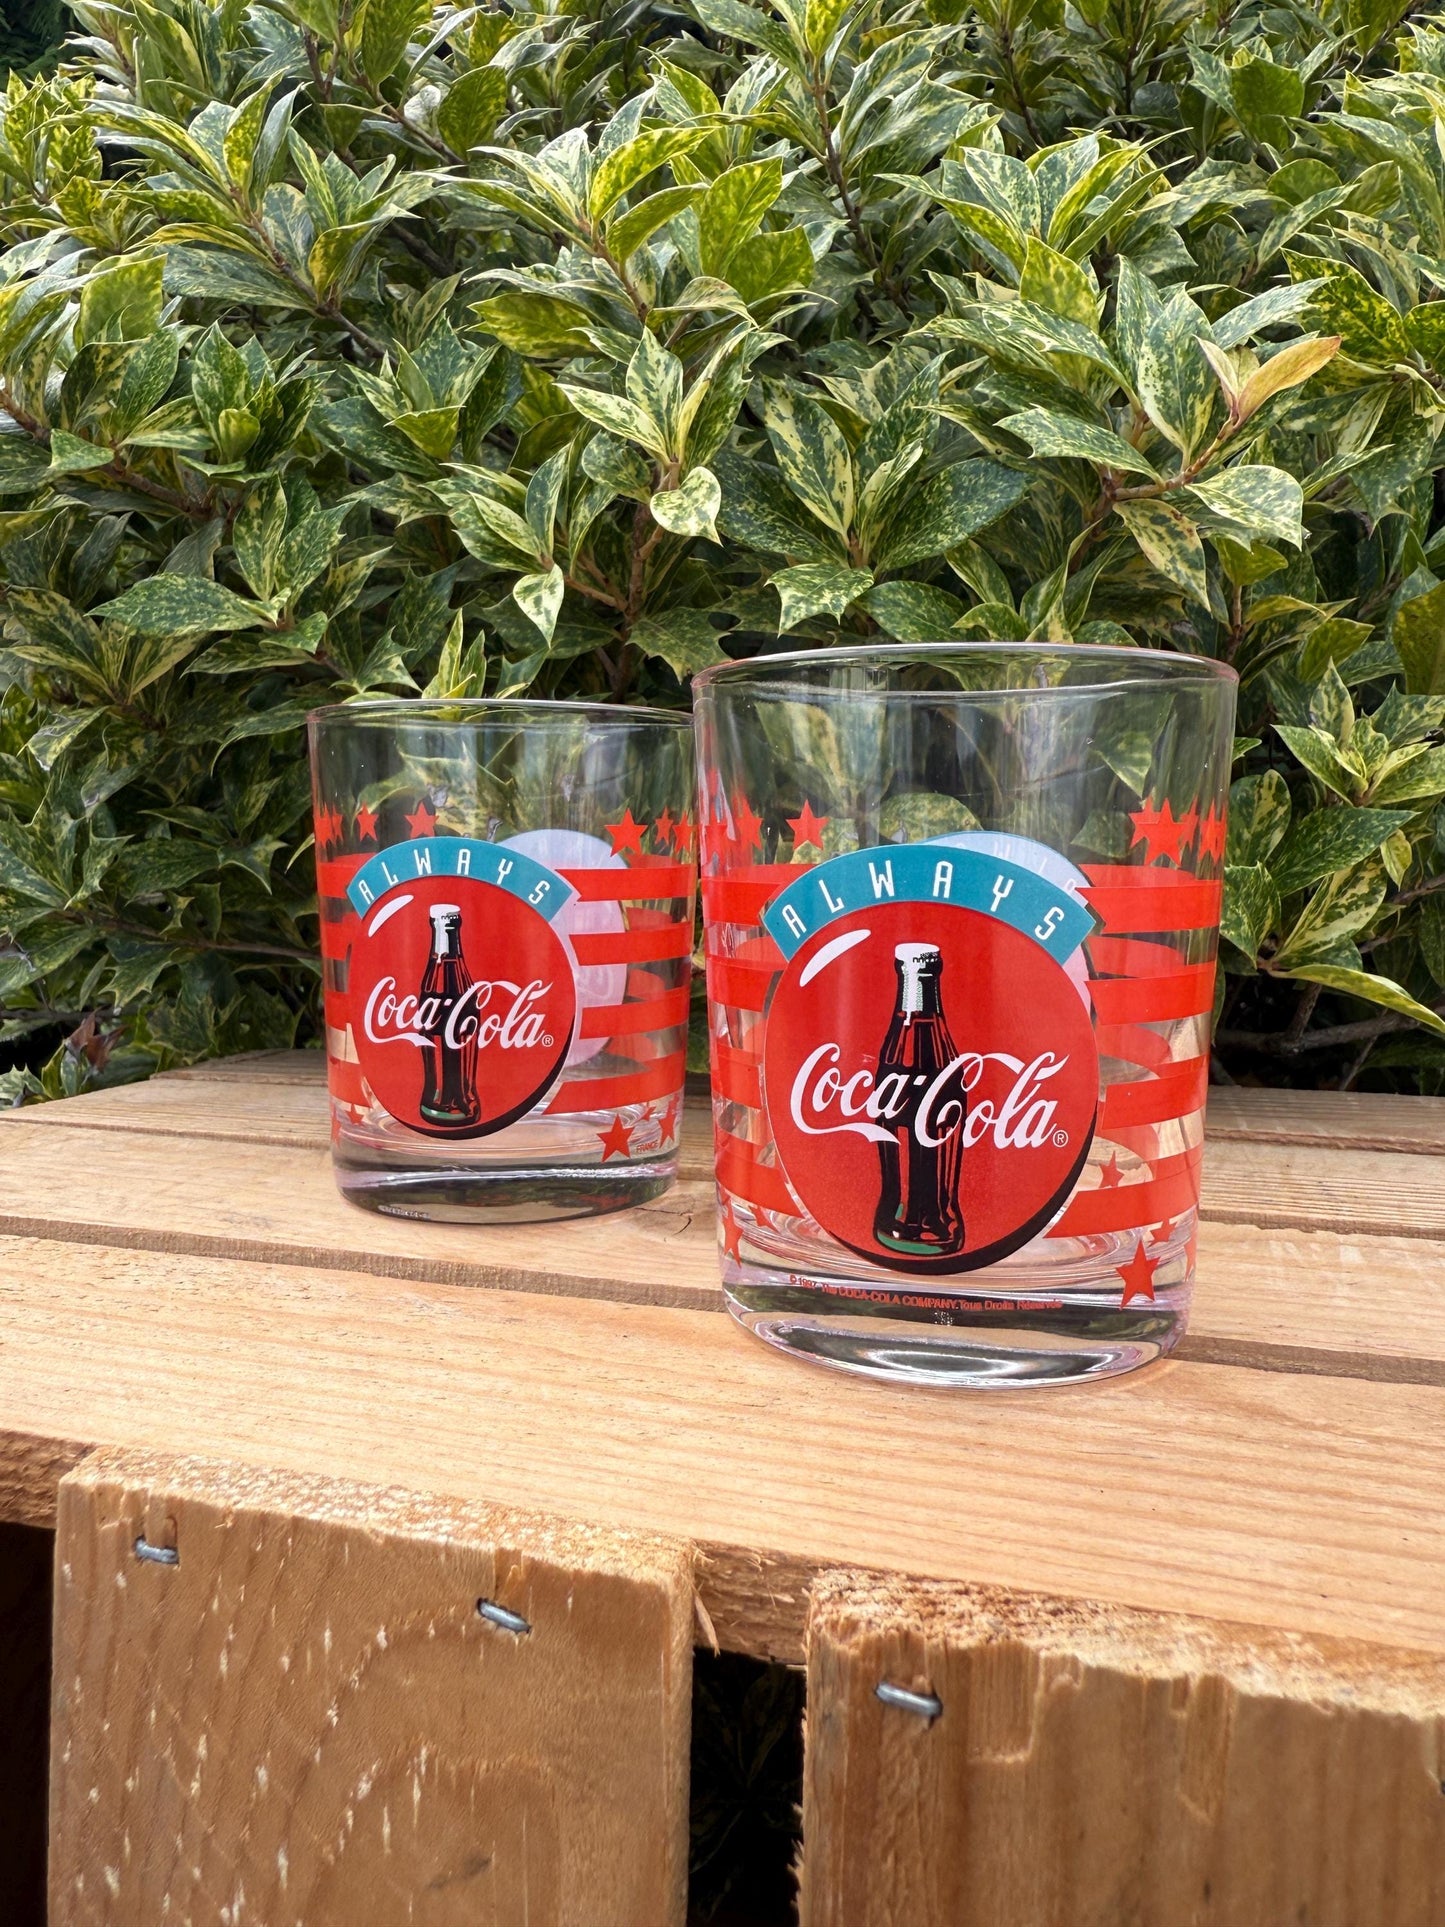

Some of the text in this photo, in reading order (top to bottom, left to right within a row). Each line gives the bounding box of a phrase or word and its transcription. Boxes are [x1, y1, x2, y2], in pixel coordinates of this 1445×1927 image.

[358, 847, 551, 905] ALWAYS
[781, 860, 1065, 941] ALWAYS
[636, 1139, 659, 1153] FRANCE
[838, 1287, 901, 1305] COCA-COLA
[984, 1299, 1014, 1310] Droits
